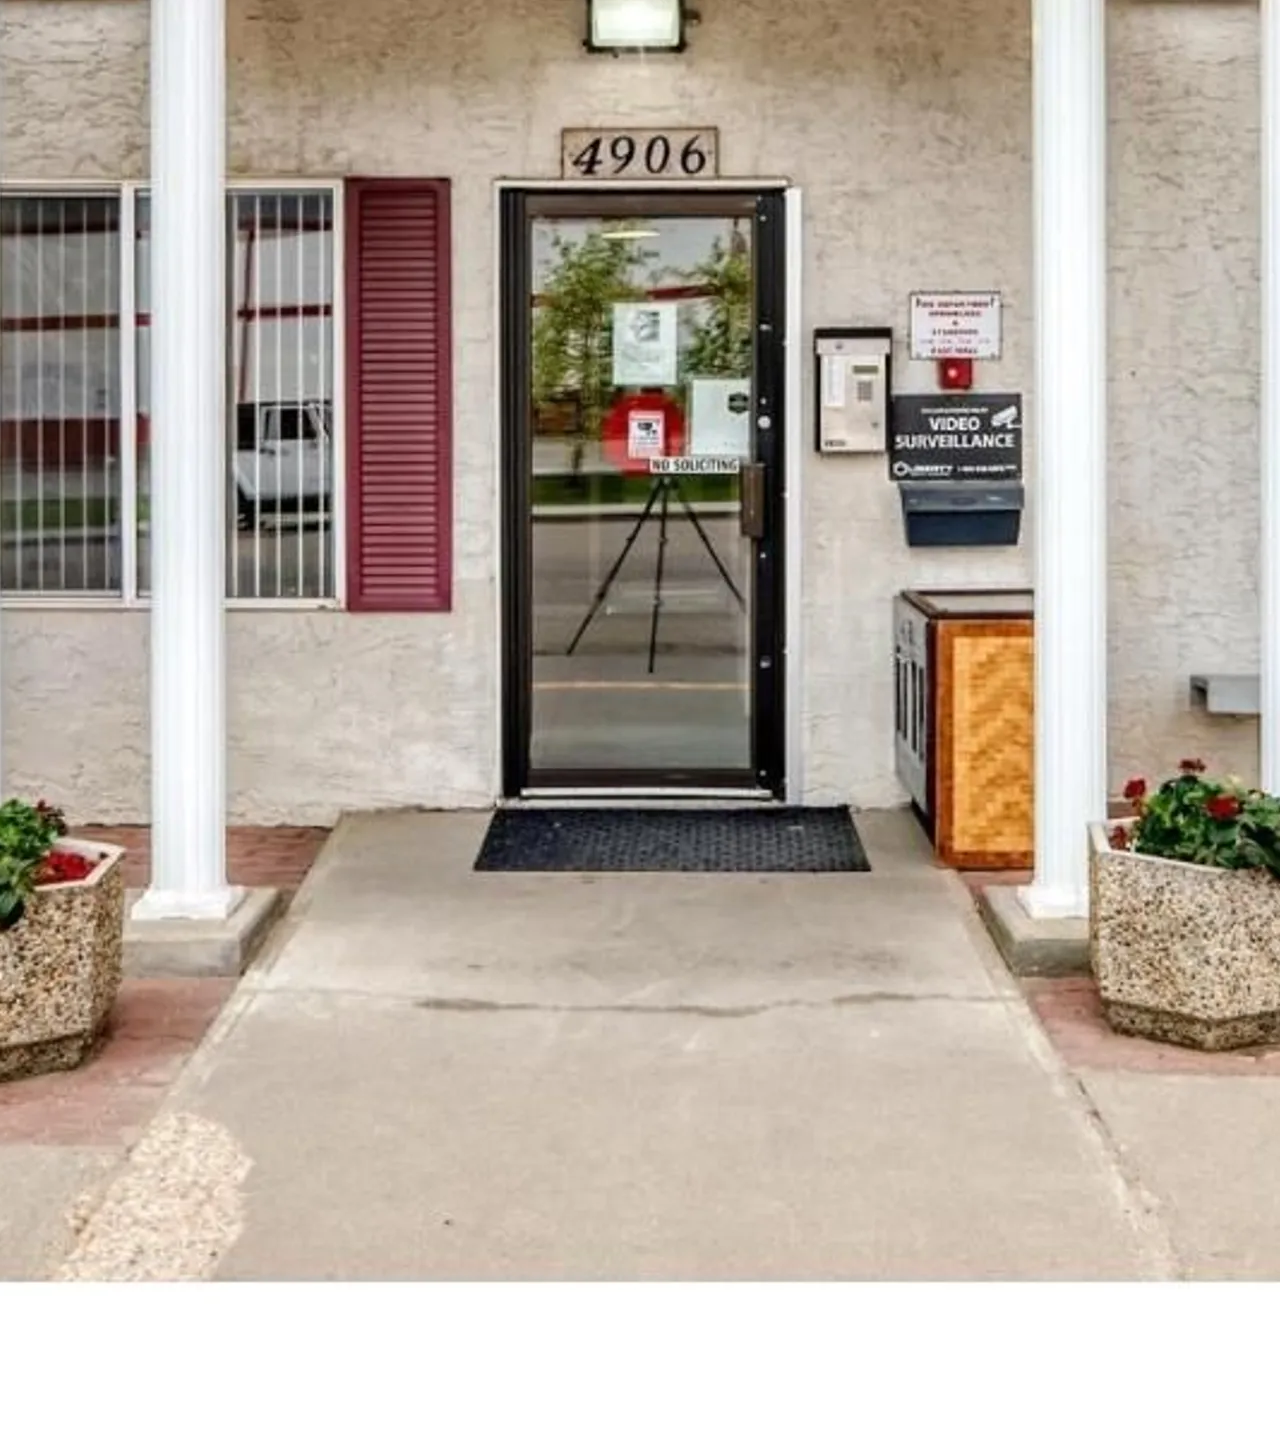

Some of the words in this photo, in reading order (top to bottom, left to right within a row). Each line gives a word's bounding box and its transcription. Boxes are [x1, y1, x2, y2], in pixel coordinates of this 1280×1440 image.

[572, 134, 706, 175] 4906
[928, 416, 981, 431] VIDEO
[895, 433, 1015, 450] SURVEILLANCE
[652, 459, 671, 472] NO
